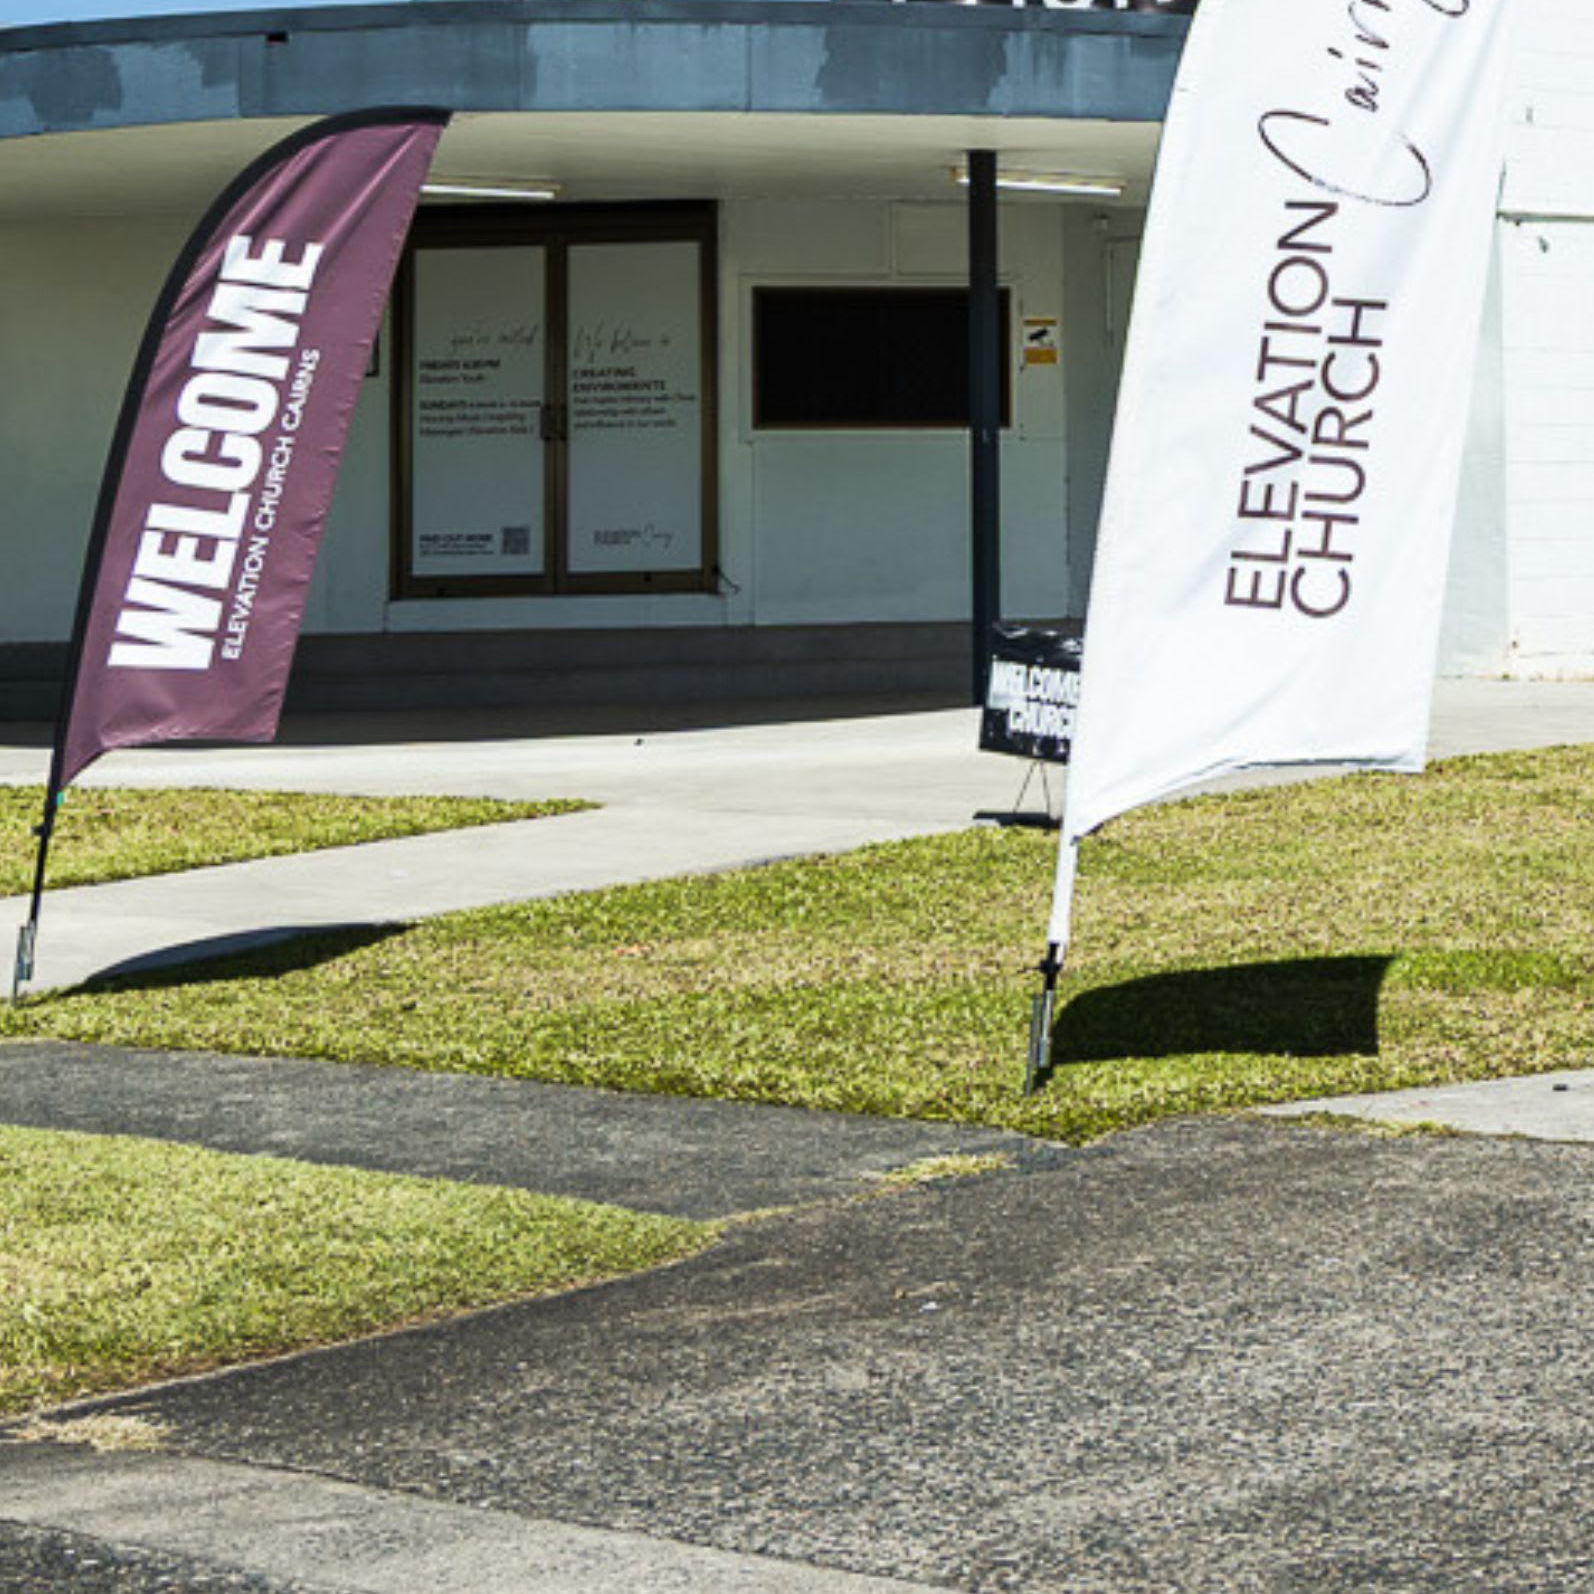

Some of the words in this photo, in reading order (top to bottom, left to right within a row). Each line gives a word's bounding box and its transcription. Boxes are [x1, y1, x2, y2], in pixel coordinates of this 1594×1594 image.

[106, 233, 326, 671] WELCOME
[220, 535, 271, 661] ELEVATION
[253, 434, 295, 532] CHURCH
[280, 346, 321, 432] CAIRNS
[1224, 200, 1339, 611] ELEVATION
[1289, 296, 1390, 619] CHURCH
[1008, 701, 1078, 740] CHURC
